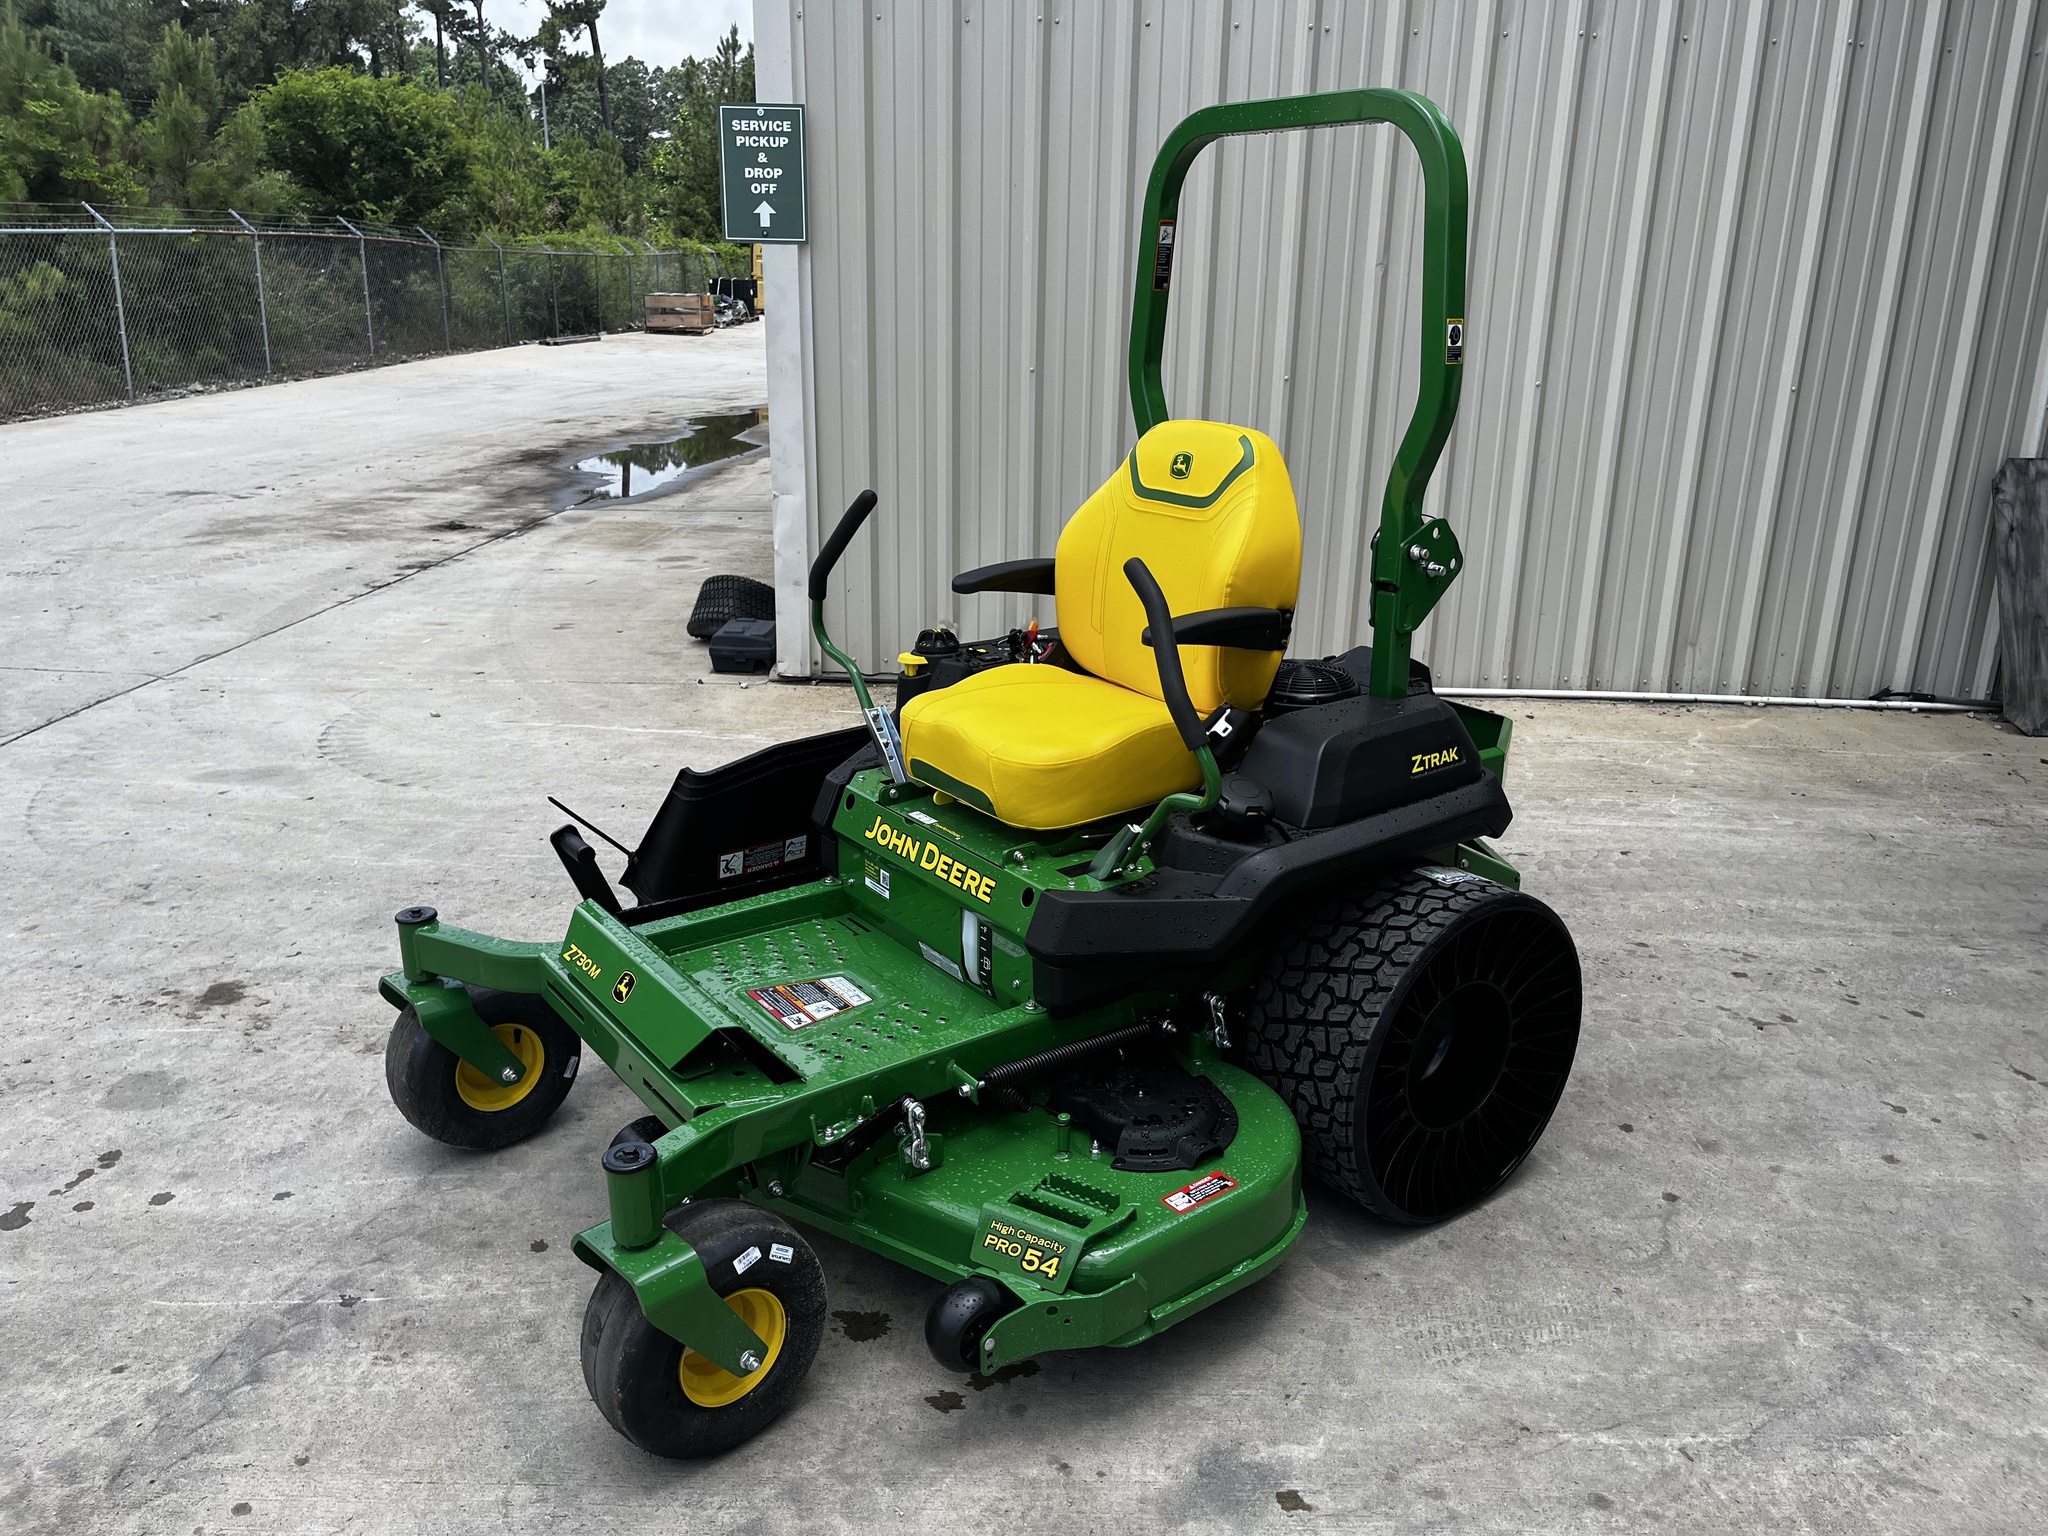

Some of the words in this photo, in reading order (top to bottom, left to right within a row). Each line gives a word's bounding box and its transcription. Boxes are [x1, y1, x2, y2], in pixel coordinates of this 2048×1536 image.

[732, 119, 792, 132] SERVICE
[736, 136, 789, 147] PICKUP
[757, 152, 768, 163] &
[744, 168, 783, 178] DROP
[750, 183, 777, 194] OFF
[1412, 746, 1459, 773] ZTRAK
[864, 815, 920, 863] JOHN
[919, 841, 997, 904] DEERE
[562, 943, 602, 980] Z730M
[990, 1220, 1015, 1236] High
[1016, 1229, 1067, 1254] Capacity
[984, 1234, 1022, 1257] PRO
[1022, 1248, 1060, 1278] 54
